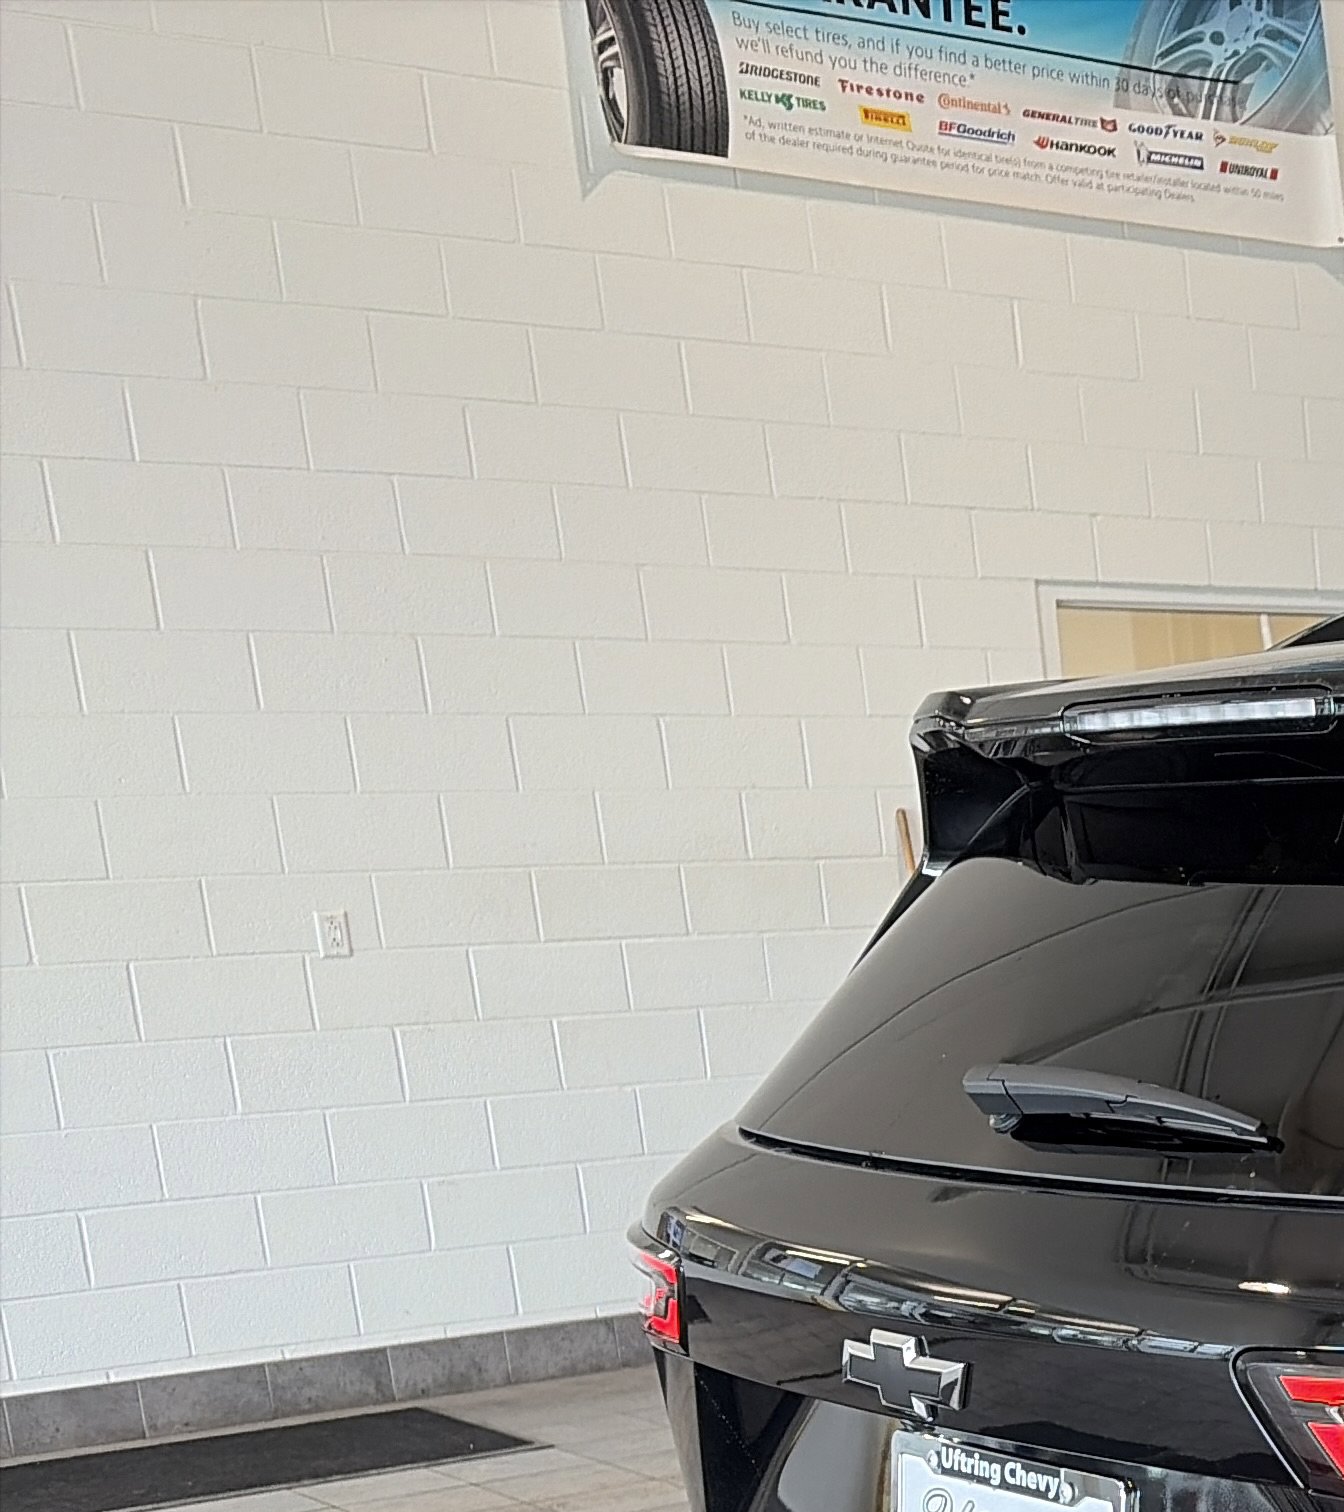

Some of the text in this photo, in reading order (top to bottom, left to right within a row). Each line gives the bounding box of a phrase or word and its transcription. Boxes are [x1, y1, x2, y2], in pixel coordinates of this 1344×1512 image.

[732, 11, 760, 32] Buy
[765, 20, 809, 41] select
[815, 26, 851, 47] tires,
[857, 35, 885, 51] and
[890, 39, 902, 54] if
[906, 43, 933, 62] you
[939, 45, 966, 65] find
[971, 54, 980, 67] a
[984, 54, 1027, 76] better
[1031, 64, 1064, 82] price
[1069, 69, 1110, 90] within
[1114, 76, 1129, 93] 30
[1132, 79, 1164, 99] days
[736, 37, 771, 55] we'll
[775, 43, 823, 65] refund
[829, 53, 857, 70] you
[863, 57, 888, 75] the
[738, 61, 821, 87] BRIDGESTONE
[739, 88, 827, 112] KELLY TIRES
[838, 79, 925, 104] Firestone
[937, 92, 1003, 115] Continental
[768, 121, 805, 134] written
[808, 127, 851, 140] estimate
[866, 133, 903, 149] Internet
[938, 120, 1016, 144] BFGoodrich
[1128, 122, 1203, 142] GOODYEAR
[745, 130, 756, 141] of
[759, 132, 776, 144] the
[778, 135, 809, 149] dealer
[813, 141, 854, 156] required
[856, 146, 888, 162] during
[890, 152, 937, 168] guarantee
[1150, 153, 1202, 168] MICHELIN
[940, 1446, 1061, 1501] Uftring Chevy
